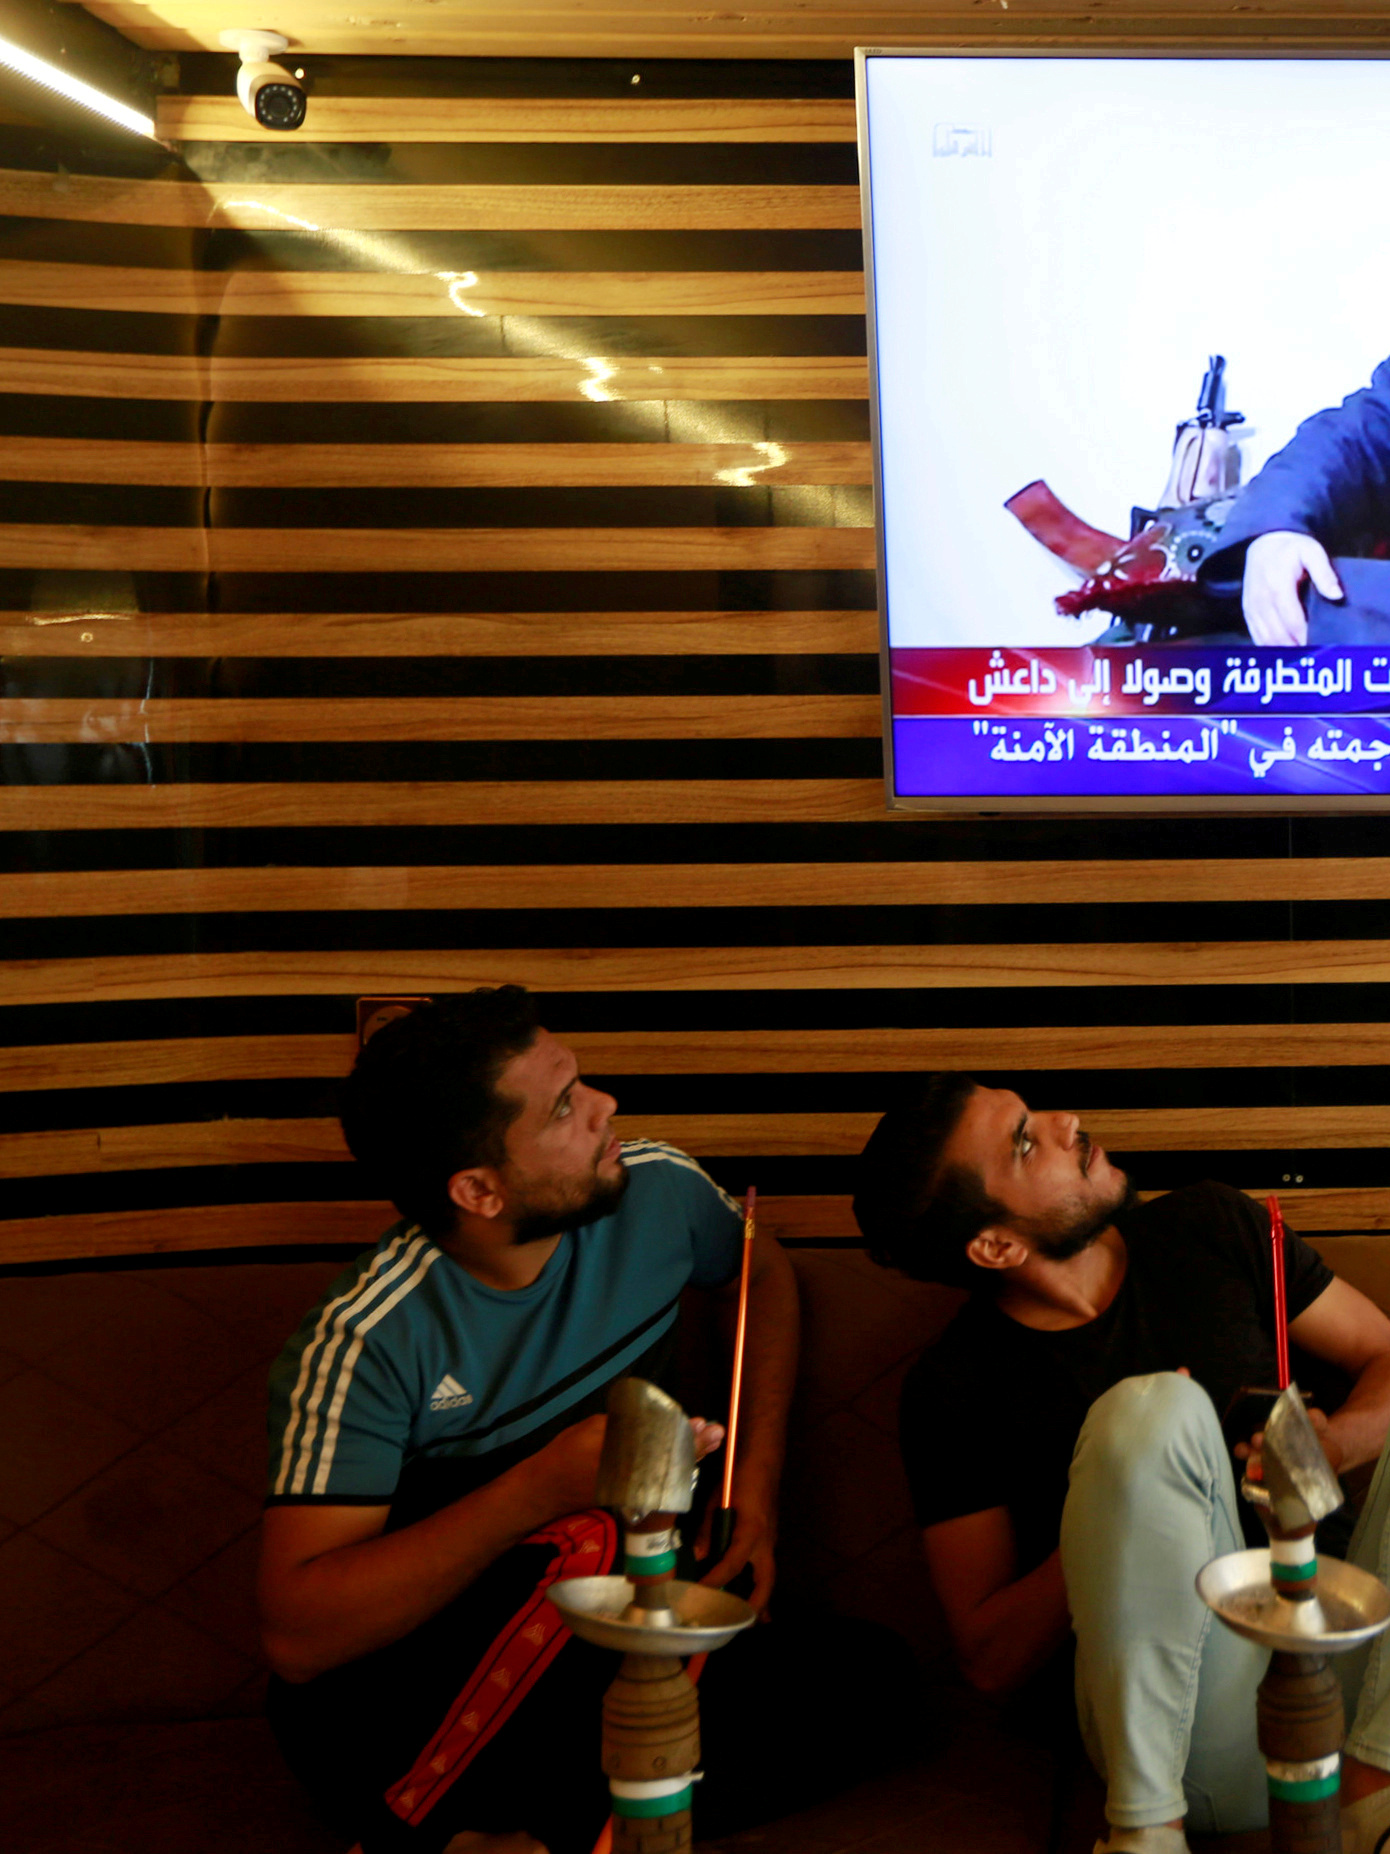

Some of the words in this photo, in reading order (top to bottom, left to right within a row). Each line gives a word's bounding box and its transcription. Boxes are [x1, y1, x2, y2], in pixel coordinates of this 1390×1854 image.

[967, 650, 1057, 706] داعش
[1067, 658, 1111, 706] إلى
[1121, 658, 1212, 706] وصولا
[1222, 656, 1352, 705] المتطرفة
[1248, 726, 1297, 778] في
